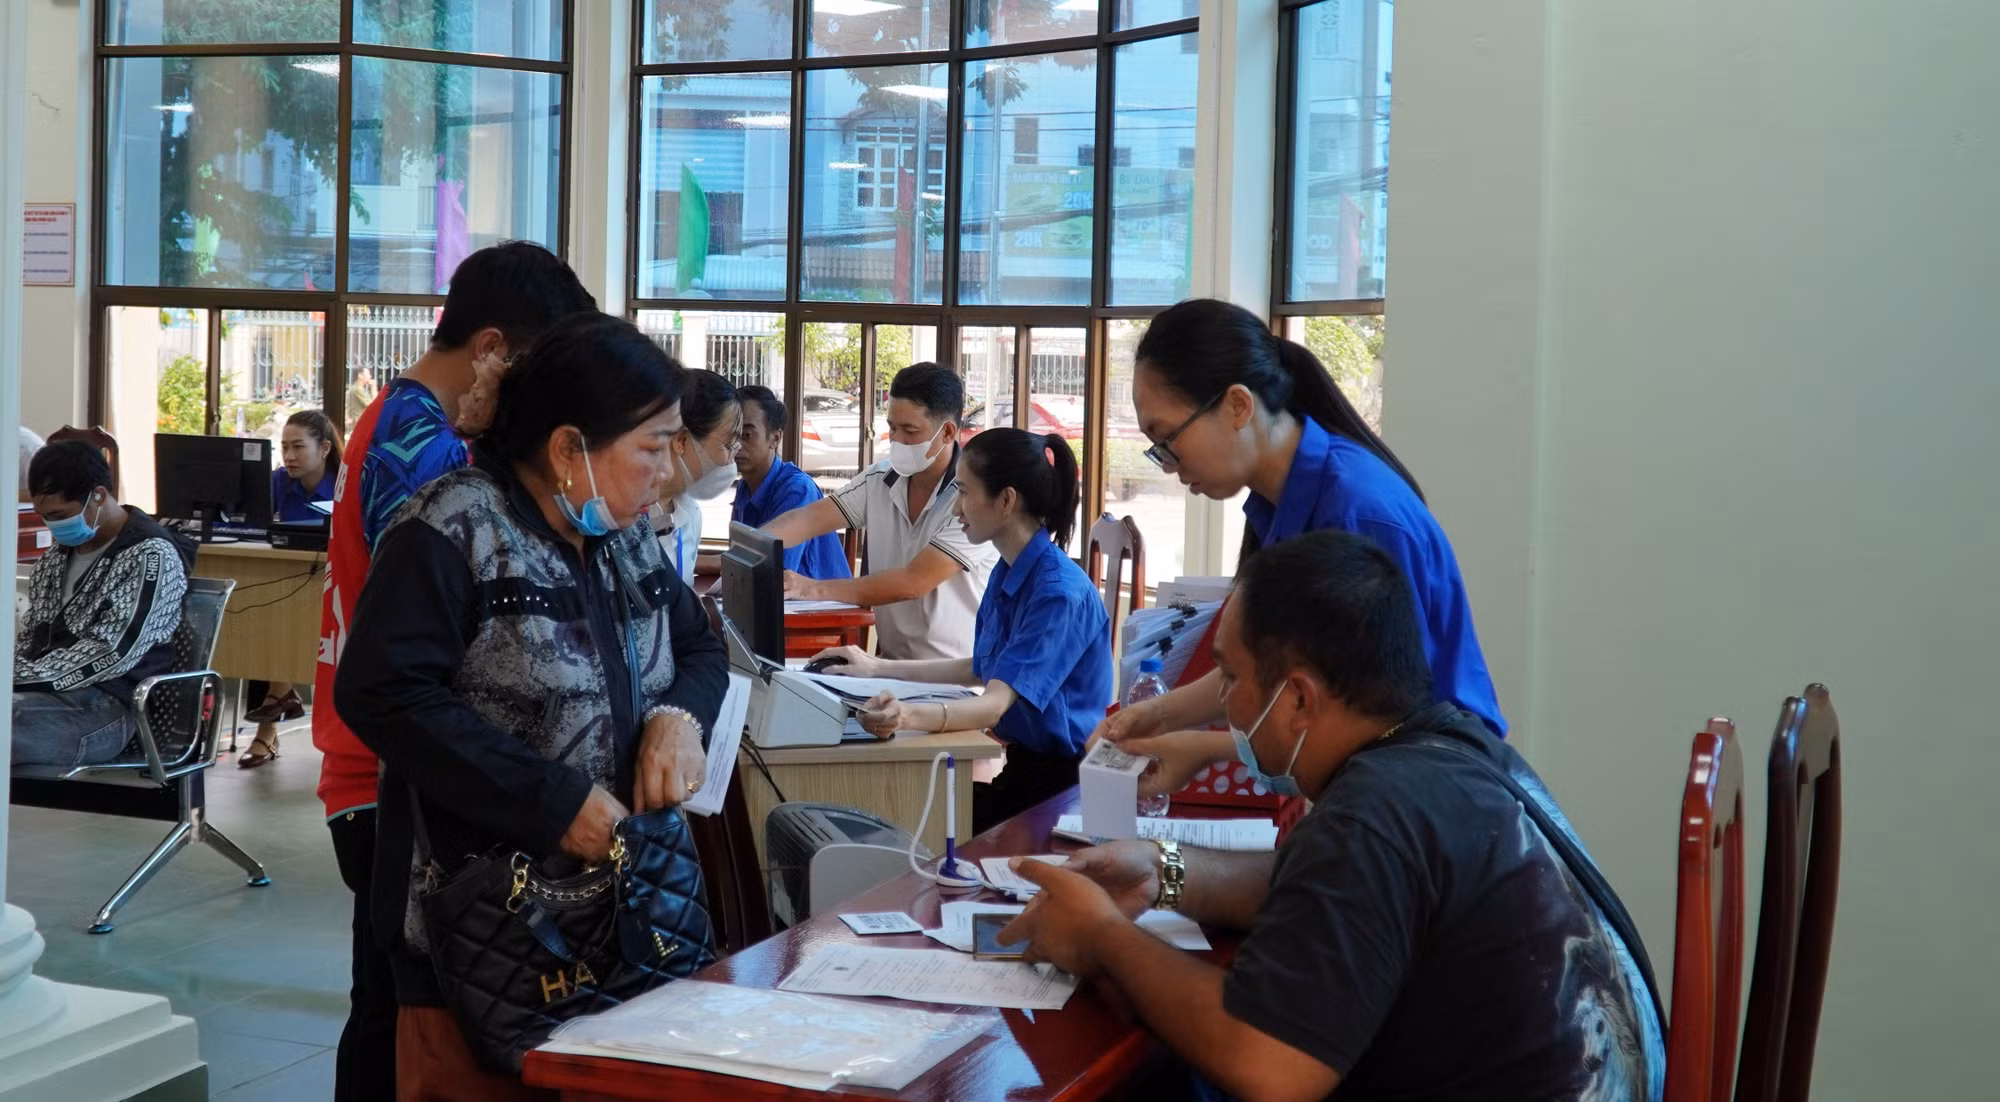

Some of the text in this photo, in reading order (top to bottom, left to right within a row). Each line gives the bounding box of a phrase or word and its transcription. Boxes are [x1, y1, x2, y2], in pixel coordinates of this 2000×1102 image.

[1014, 230, 1043, 248] 20K
[146, 552, 160, 582] CHRIS
[53, 651, 121, 691] CHRIS DSOR
